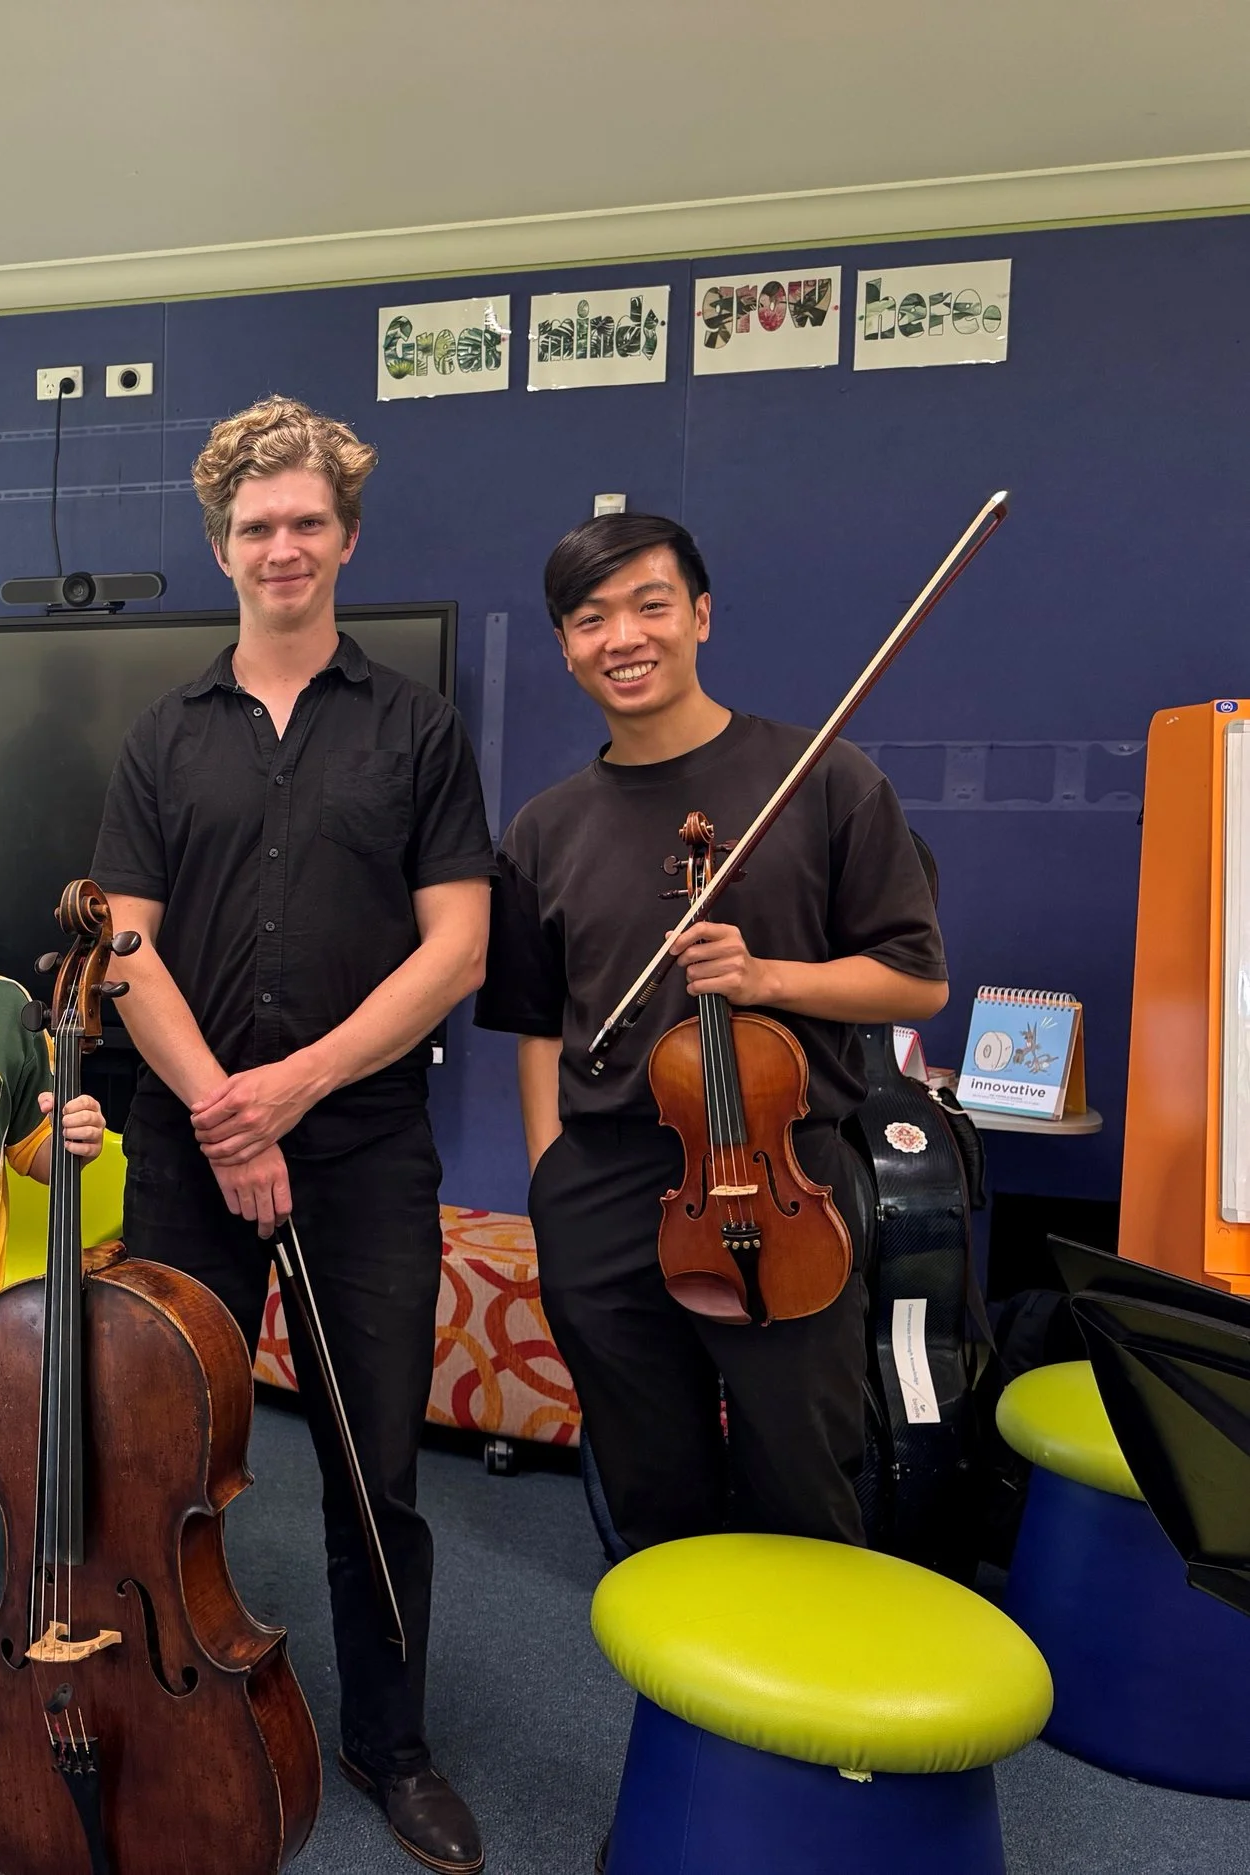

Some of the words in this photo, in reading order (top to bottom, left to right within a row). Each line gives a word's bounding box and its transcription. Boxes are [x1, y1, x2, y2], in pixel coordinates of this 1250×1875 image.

[383, 315, 502, 380] Great
[537, 294, 659, 363] minds
[701, 278, 832, 350] grow
[863, 277, 1002, 341] here.
[970, 1077, 1046, 1099] innovative
